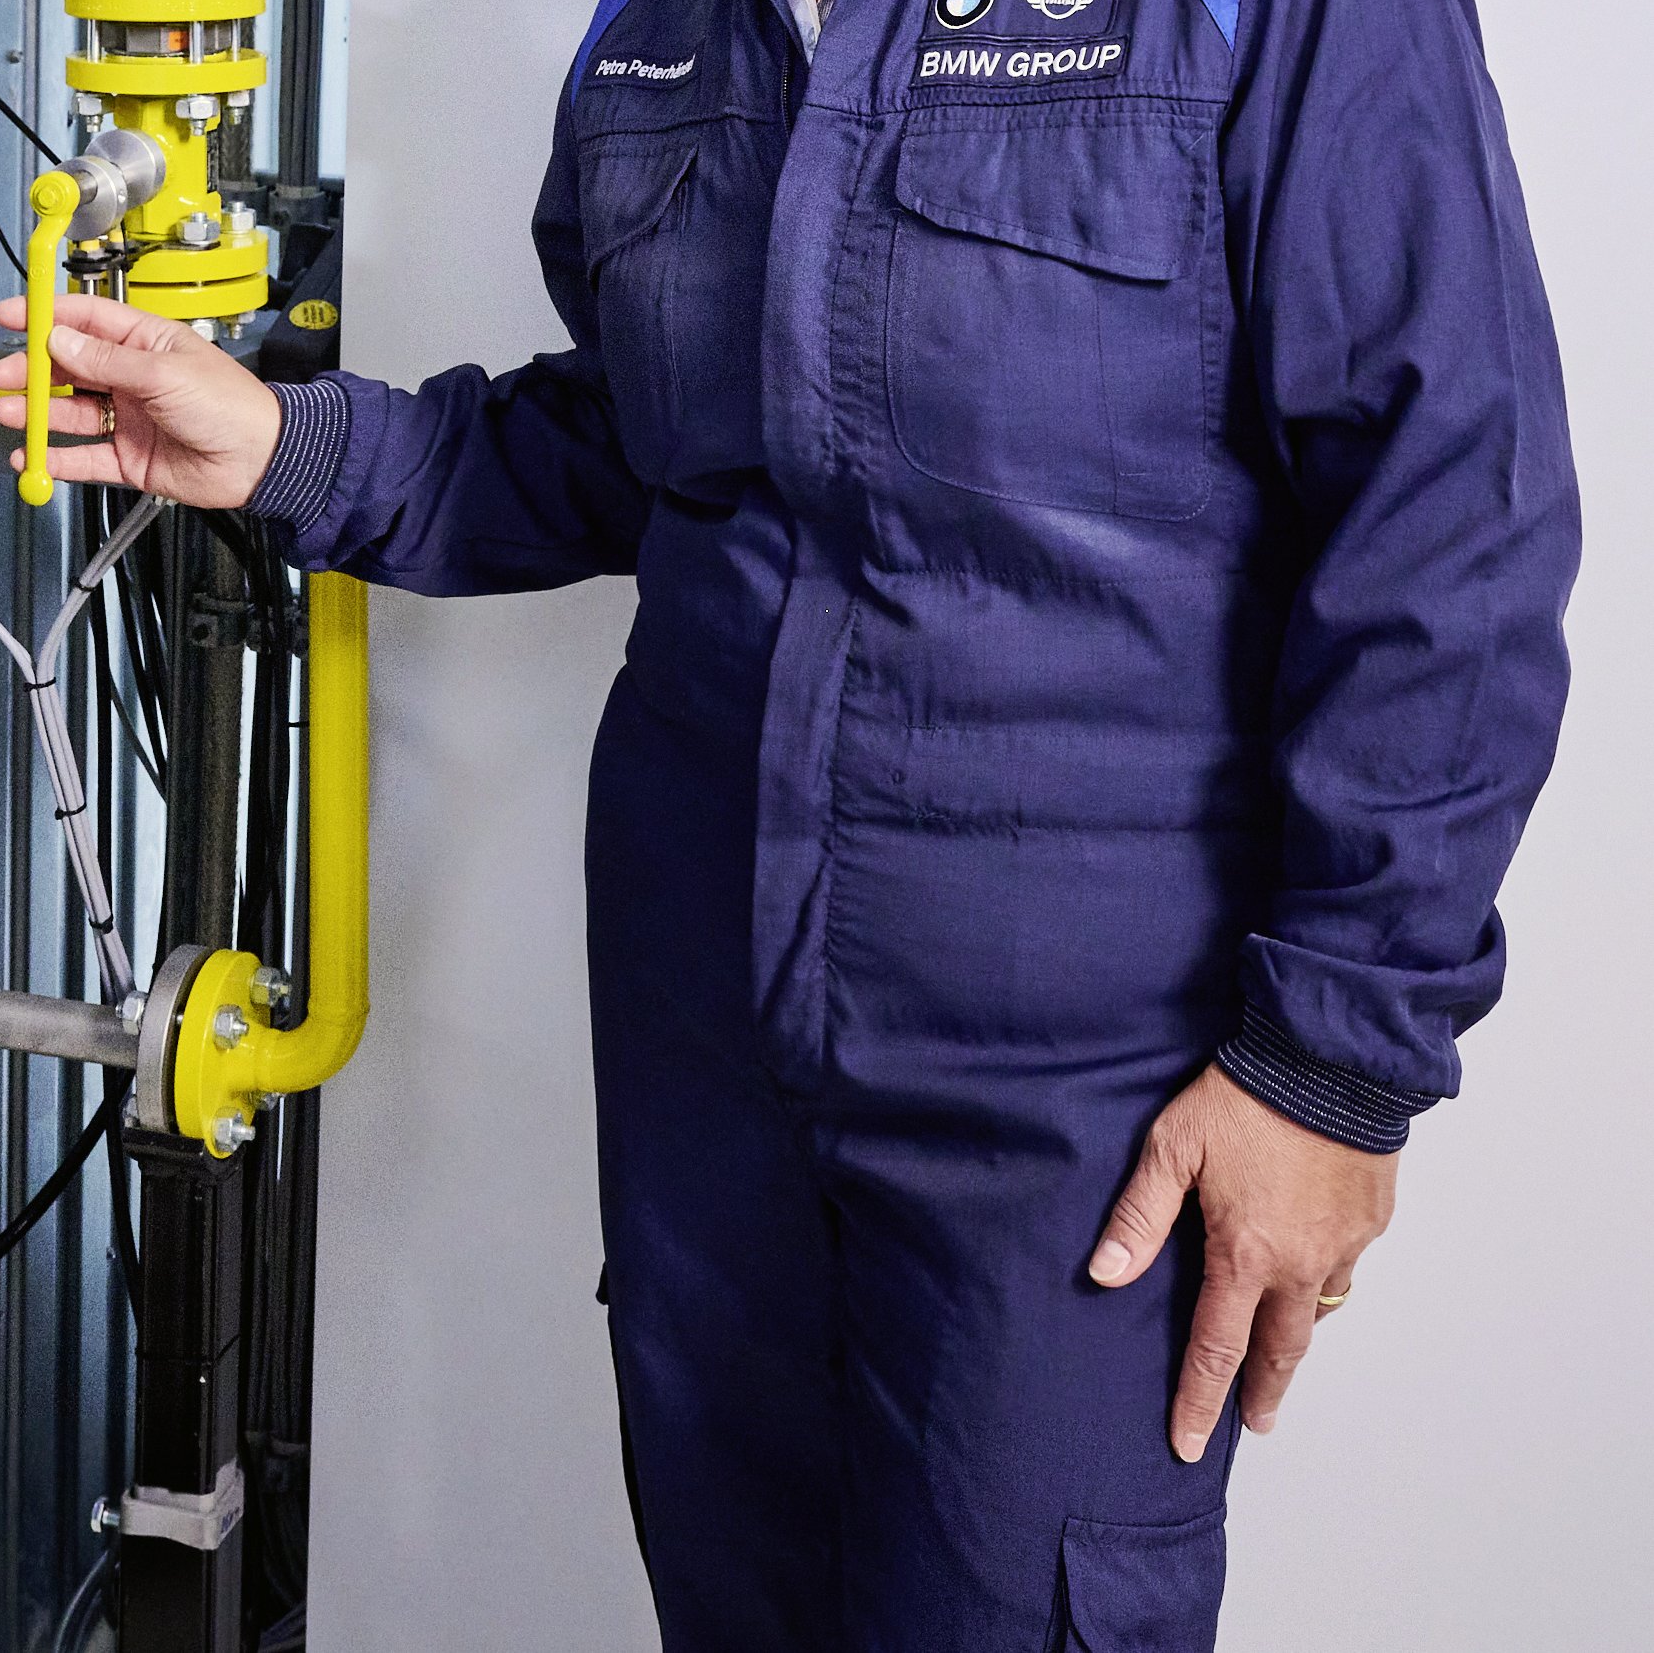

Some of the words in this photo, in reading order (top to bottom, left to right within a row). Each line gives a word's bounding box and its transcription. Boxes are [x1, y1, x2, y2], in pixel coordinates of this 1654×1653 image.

[595, 59, 627, 76] Petra
[920, 49, 1001, 78] BMW
[1006, 44, 1122, 78] GROUP
